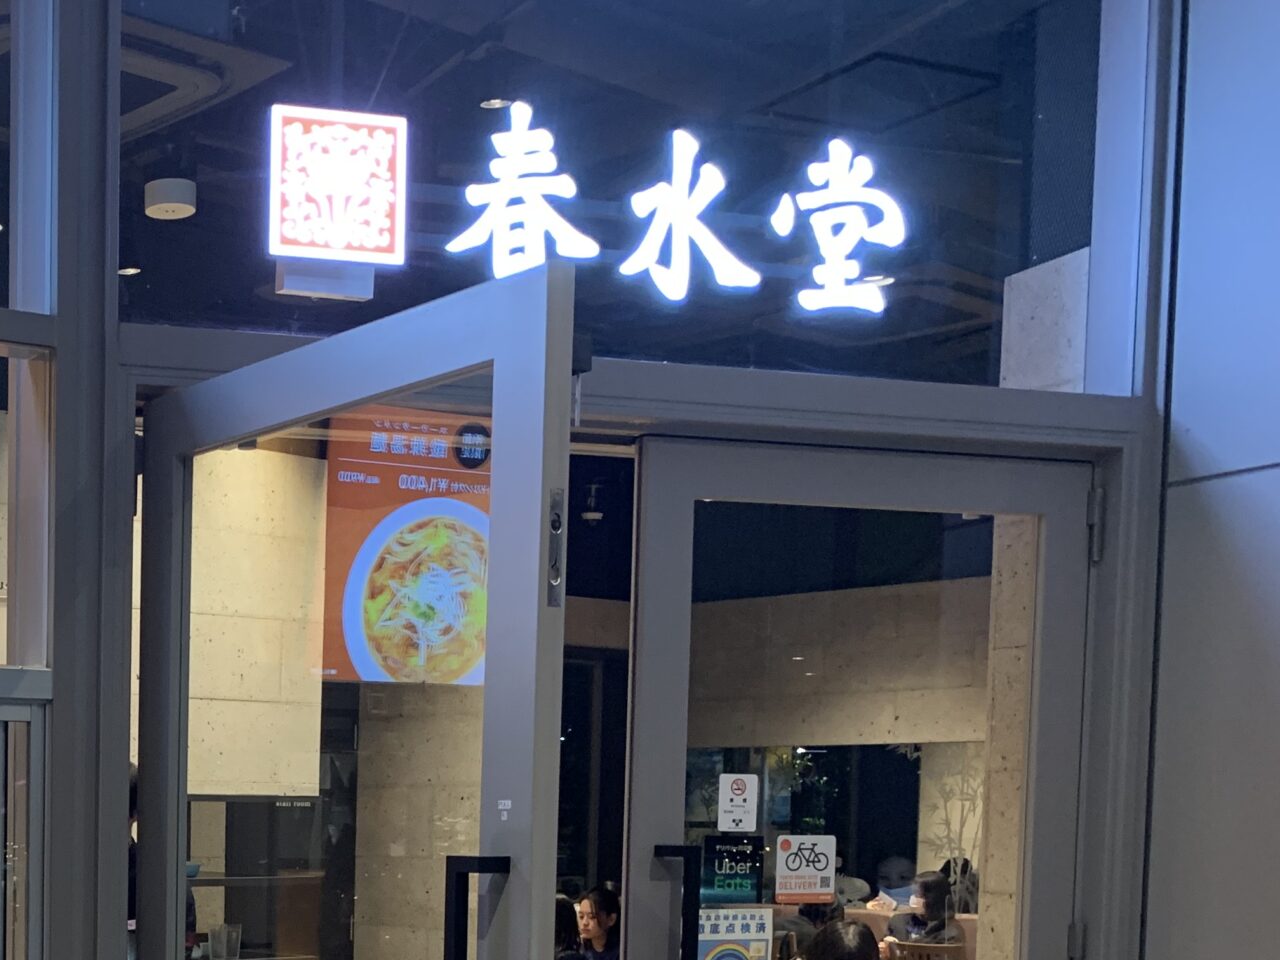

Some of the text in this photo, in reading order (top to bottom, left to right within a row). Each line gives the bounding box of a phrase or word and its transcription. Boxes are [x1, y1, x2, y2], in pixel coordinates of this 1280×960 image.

[444, 99, 907, 314] 春水堂
[714, 858, 753, 875] Uber
[714, 876, 753, 892] Eats
[778, 881, 818, 890] DELIVERY
